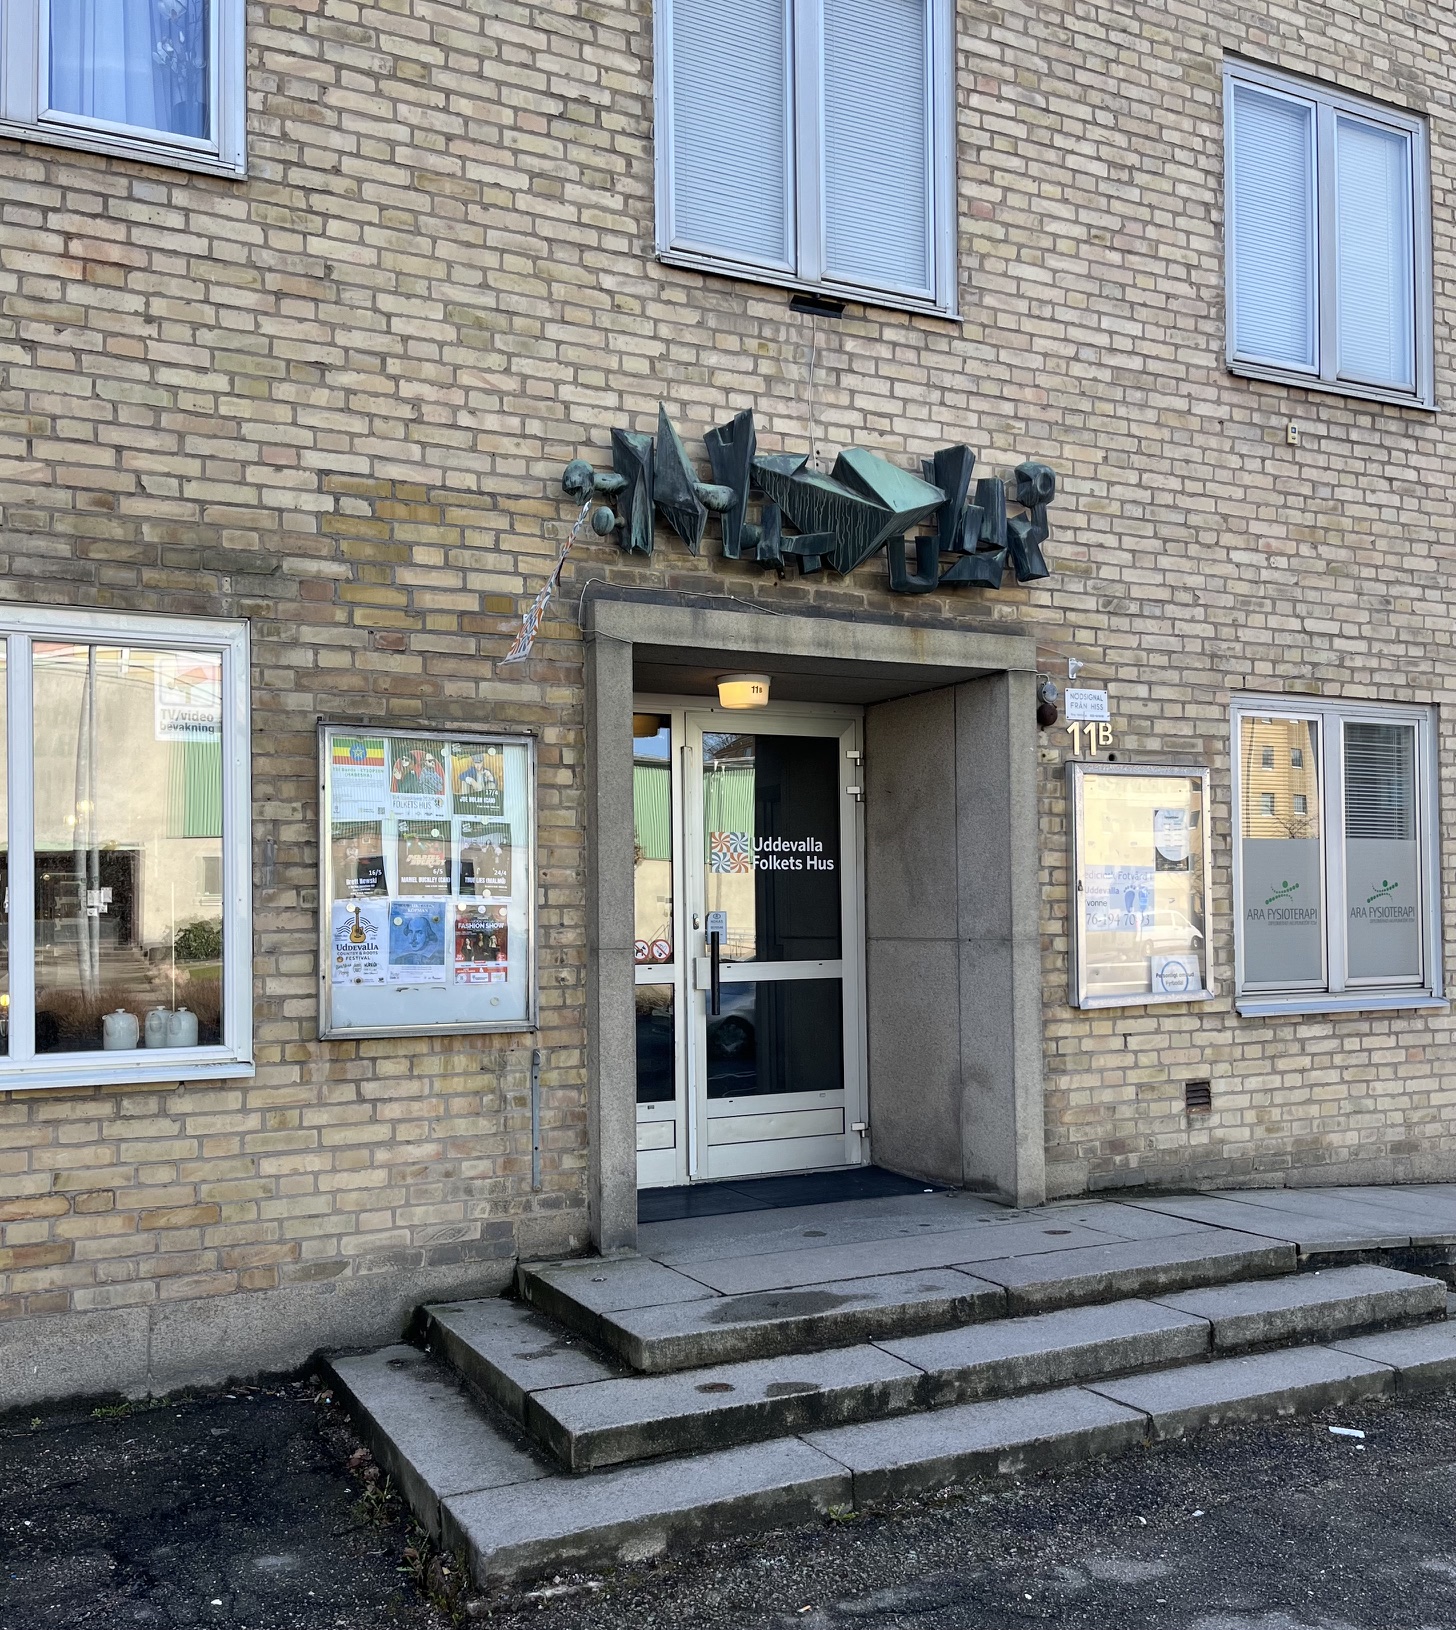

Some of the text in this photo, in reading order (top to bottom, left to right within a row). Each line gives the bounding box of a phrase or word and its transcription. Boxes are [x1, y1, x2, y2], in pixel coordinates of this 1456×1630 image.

[1070, 692, 1103, 701] NÖDSIGNAL
[1070, 701, 1088, 709] FRÅN
[160, 709, 214, 722] TV/video
[160, 721, 215, 734] bevakning
[1066, 721, 1114, 756] 11B
[392, 801, 432, 809] FOLKETS HUS
[752, 837, 823, 852] Uddevalla
[752, 855, 835, 870] Folkets Hus
[1085, 886, 1120, 894] Uddevalla
[1247, 908, 1318, 920] ARA FYSIOTERAPI
[1349, 906, 1416, 918] ARA FYSIOTERAPI
[1124, 913, 1136, 926] 70
